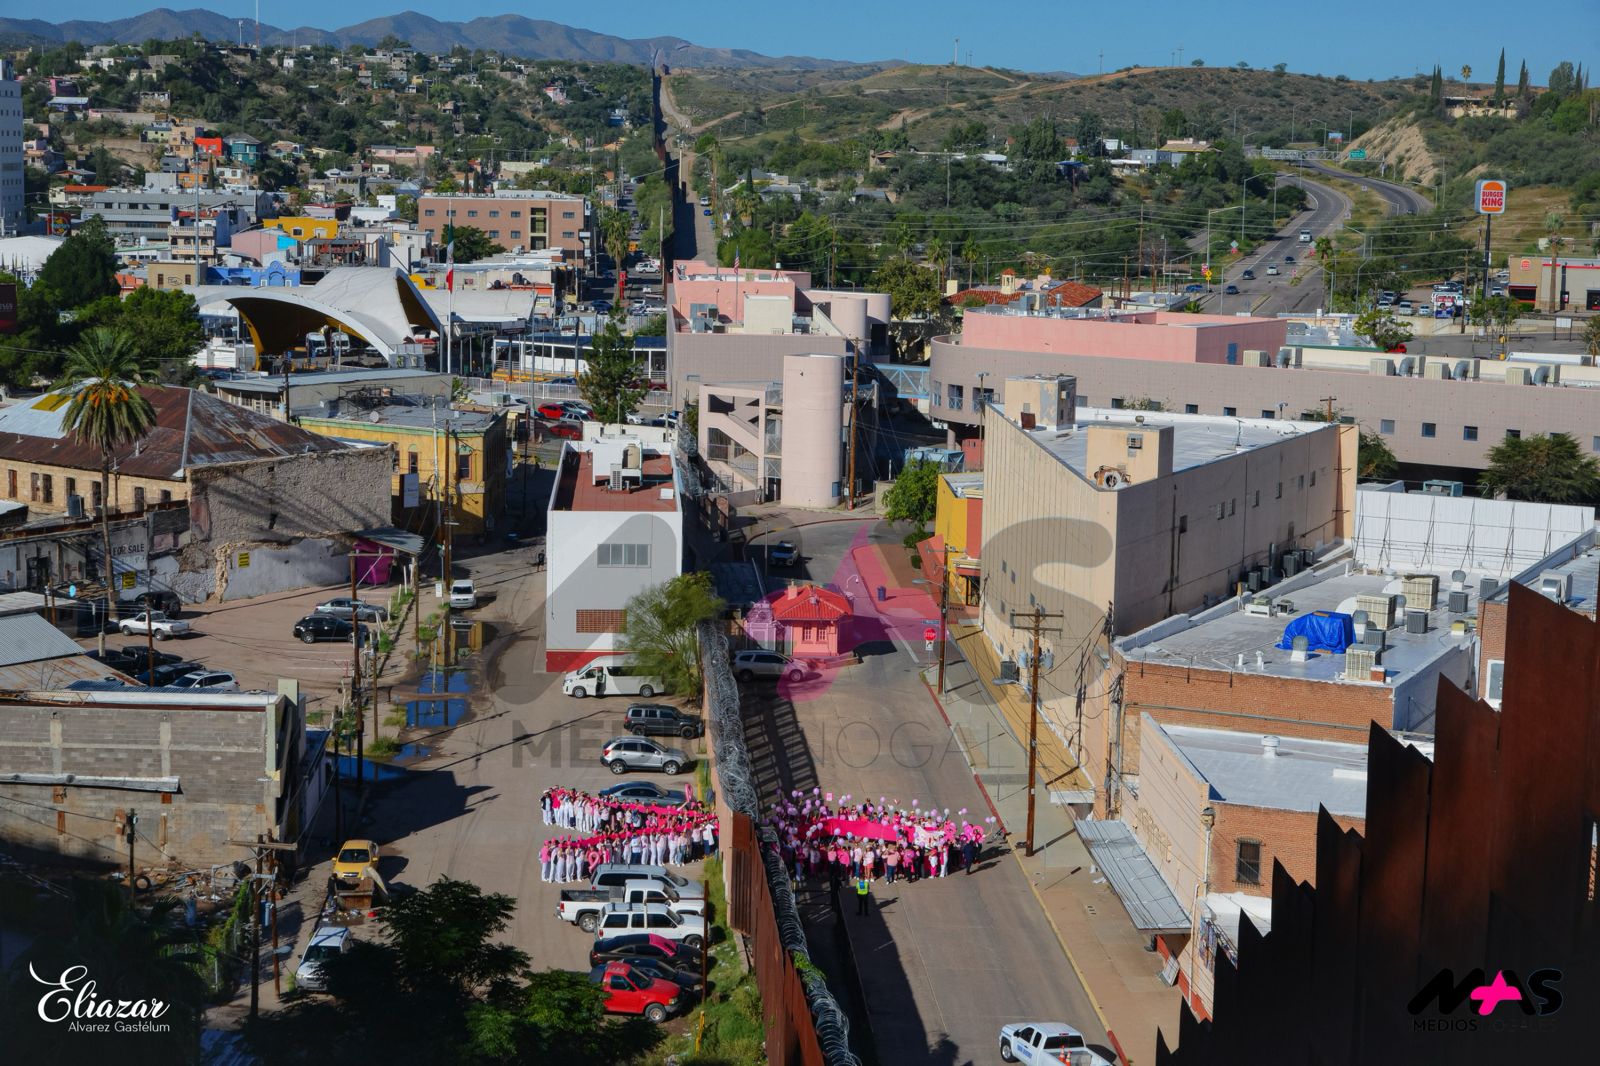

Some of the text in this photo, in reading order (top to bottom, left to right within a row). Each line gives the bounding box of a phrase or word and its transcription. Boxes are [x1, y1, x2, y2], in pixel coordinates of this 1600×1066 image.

[1482, 197, 1503, 206] KING
[113, 543, 145, 556] FOR SALE
